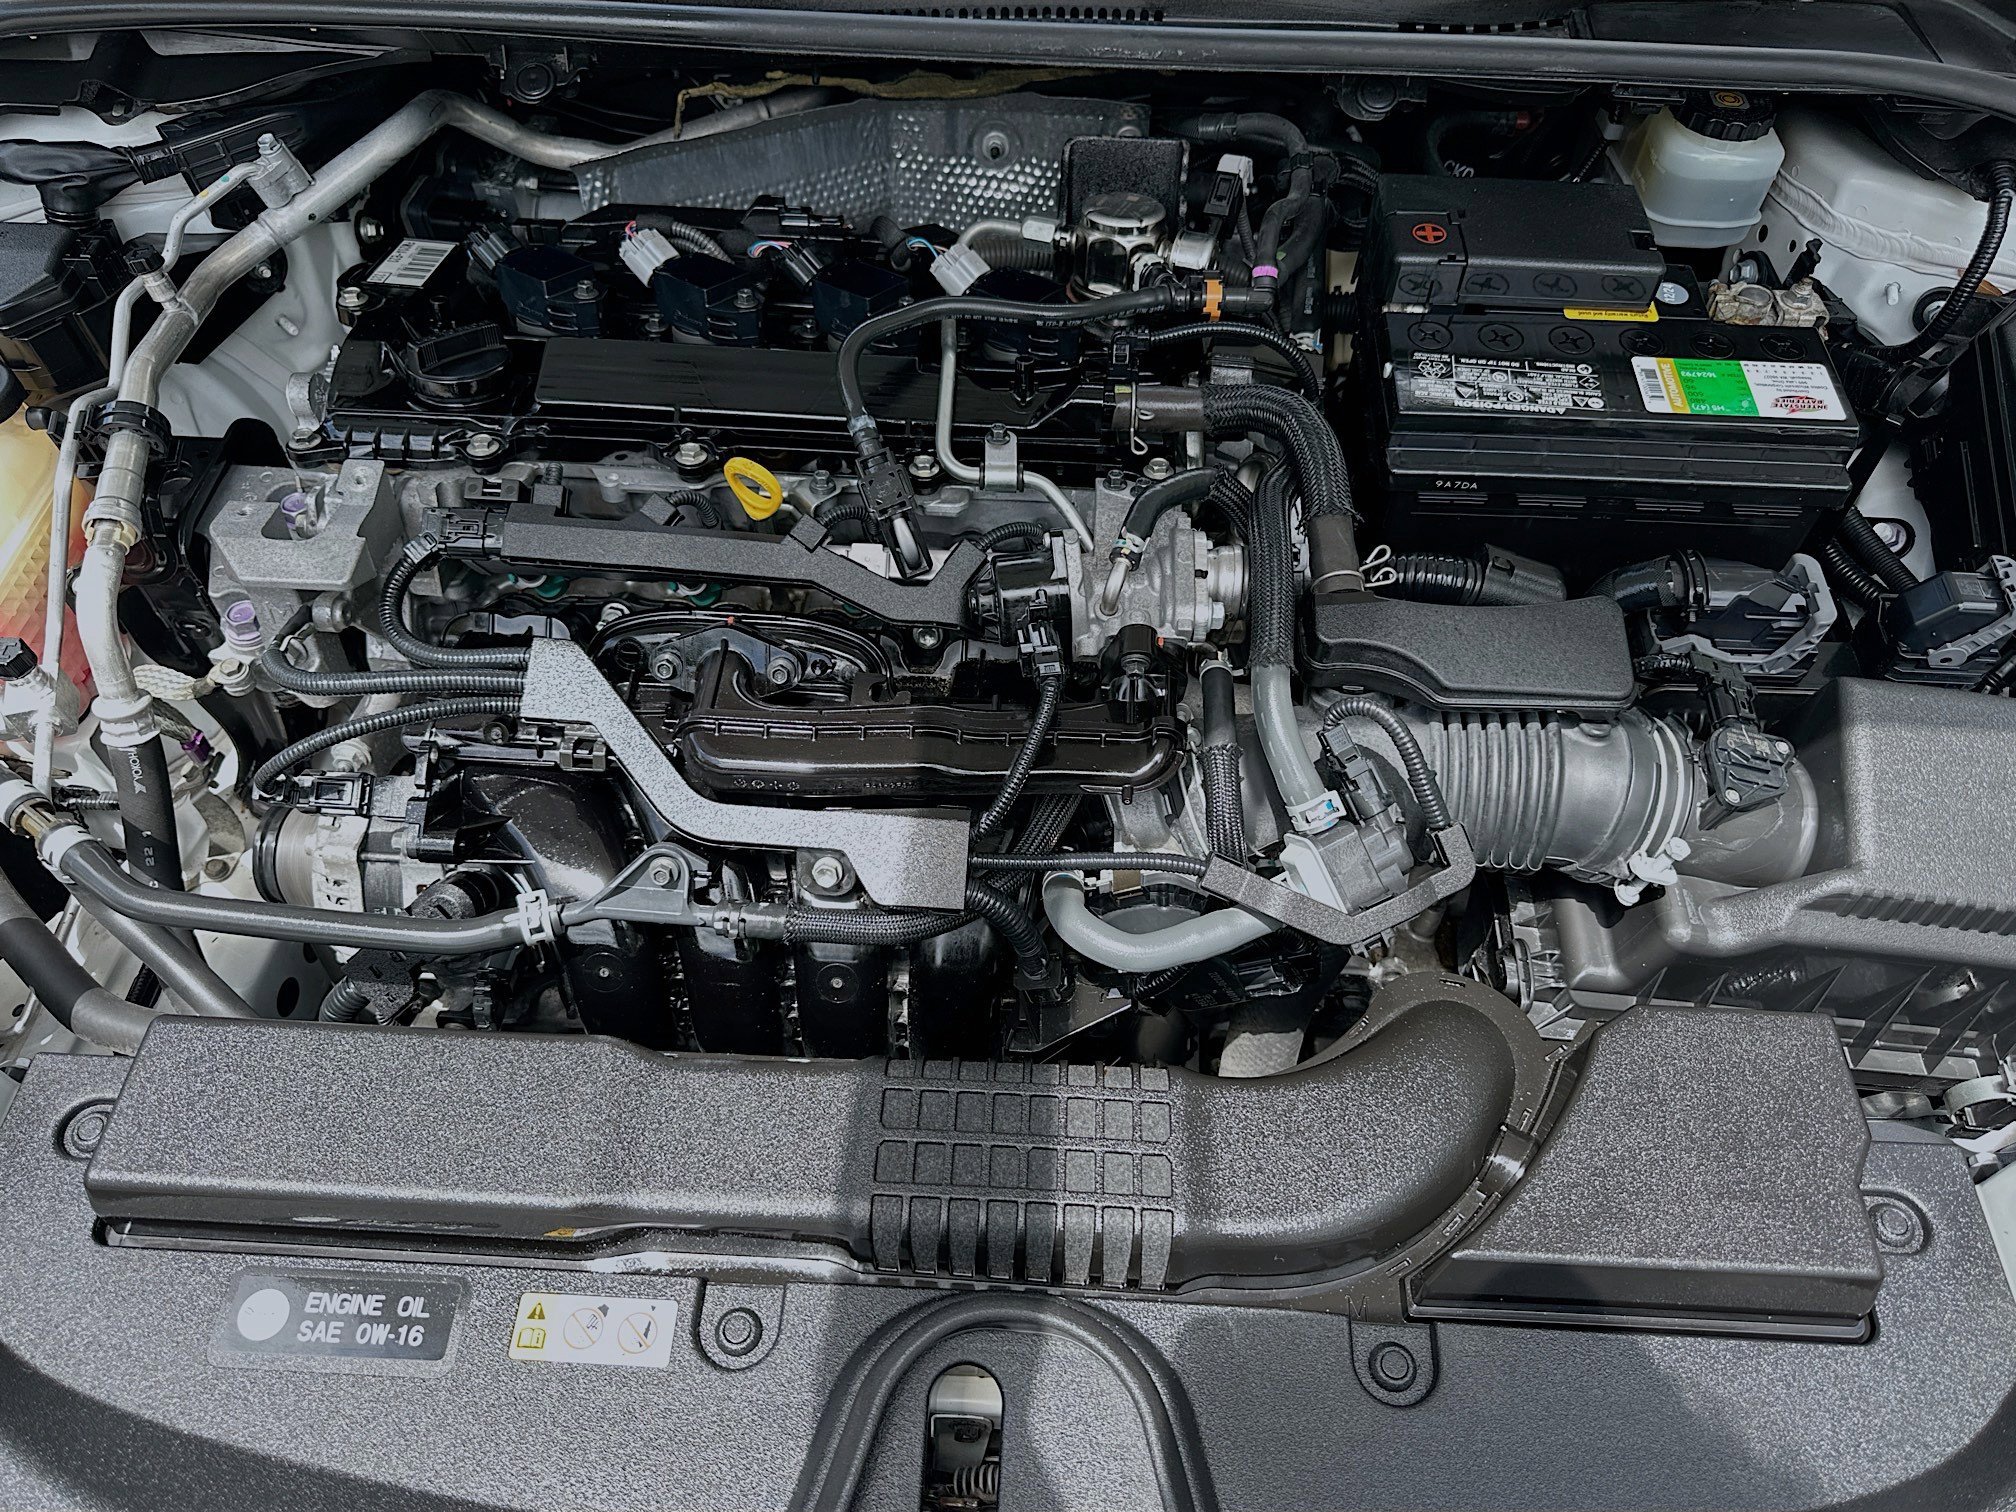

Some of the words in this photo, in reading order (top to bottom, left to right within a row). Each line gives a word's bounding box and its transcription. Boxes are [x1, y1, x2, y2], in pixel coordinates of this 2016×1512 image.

[1660, 362, 1684, 407] AUTOMOTIVE
[1435, 480, 1479, 490] 9A7DA
[304, 1292, 386, 1316] ENGINE
[398, 1295, 430, 1319] OIL
[297, 1320, 344, 1343] SAE
